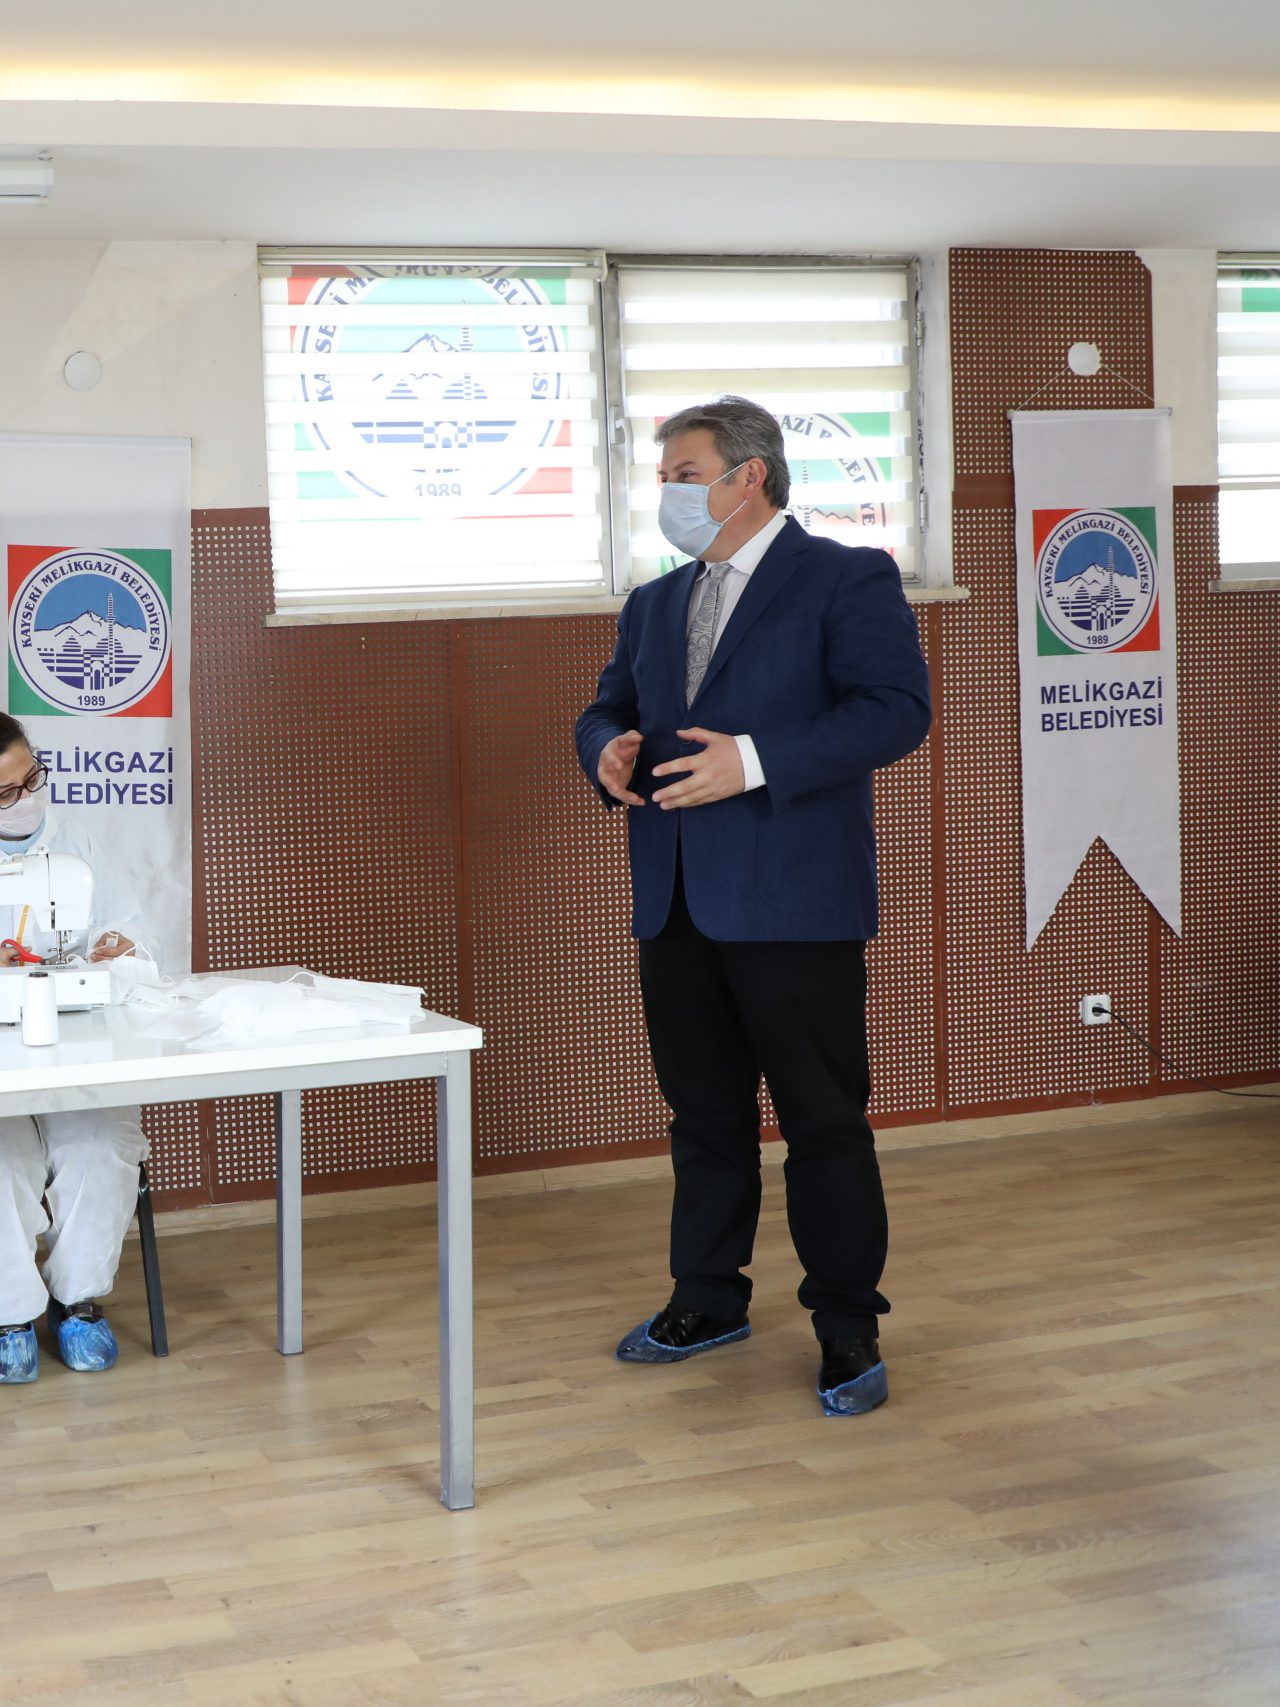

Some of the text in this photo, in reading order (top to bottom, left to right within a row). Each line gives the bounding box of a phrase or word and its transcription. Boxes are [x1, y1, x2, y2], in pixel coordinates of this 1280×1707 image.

[415, 482, 462, 497] 1989
[1042, 519, 1151, 598] KAYSERİ MELİKGAZİ BELEDİYESİ
[20, 559, 162, 651] KAYSERİ MELİKGAZİ BELEDİYESİ
[1086, 635, 1109, 645] 1989
[77, 695, 106, 706] 1989
[1040, 676, 1163, 705] MELİKGAZİ
[1041, 703, 1163, 732] BELEDİYESİ
[36, 746, 173, 774] ELİKGAZİ
[50, 779, 173, 805] LEDİYESİ
